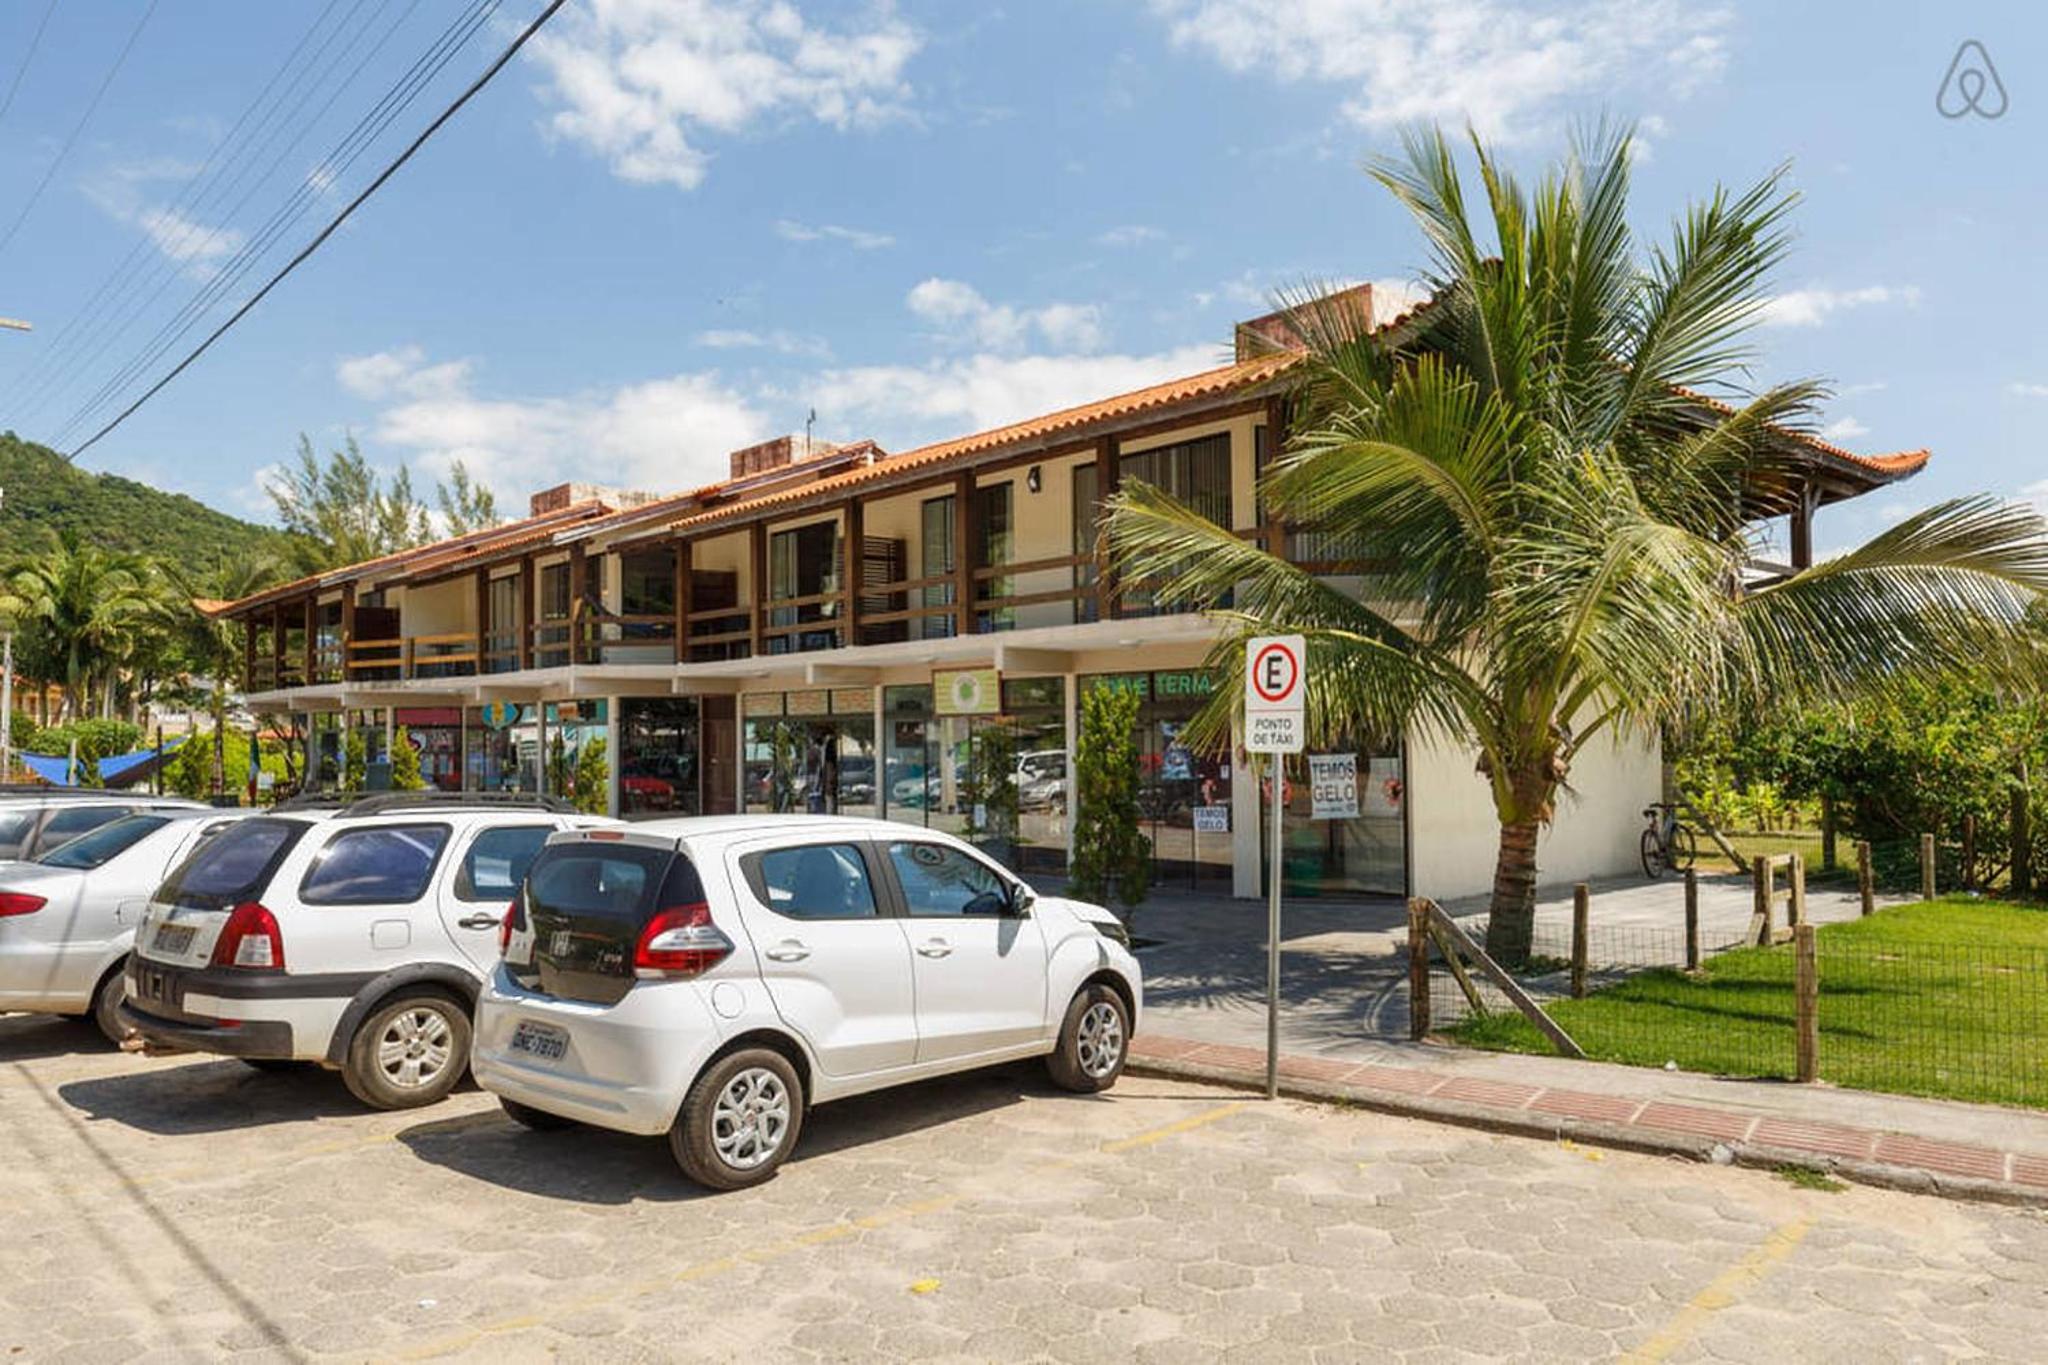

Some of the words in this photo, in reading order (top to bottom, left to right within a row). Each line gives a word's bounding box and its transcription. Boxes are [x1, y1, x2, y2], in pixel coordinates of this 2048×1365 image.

[1265, 655, 1283, 690] E
[1254, 717, 1293, 731] PONTO
[1253, 732, 1267, 745] DE
[1312, 761, 1355, 781] TEMOS
[1313, 783, 1355, 803] GELO
[1195, 808, 1226, 819] TEMOS
[1198, 818, 1224, 830] GELO
